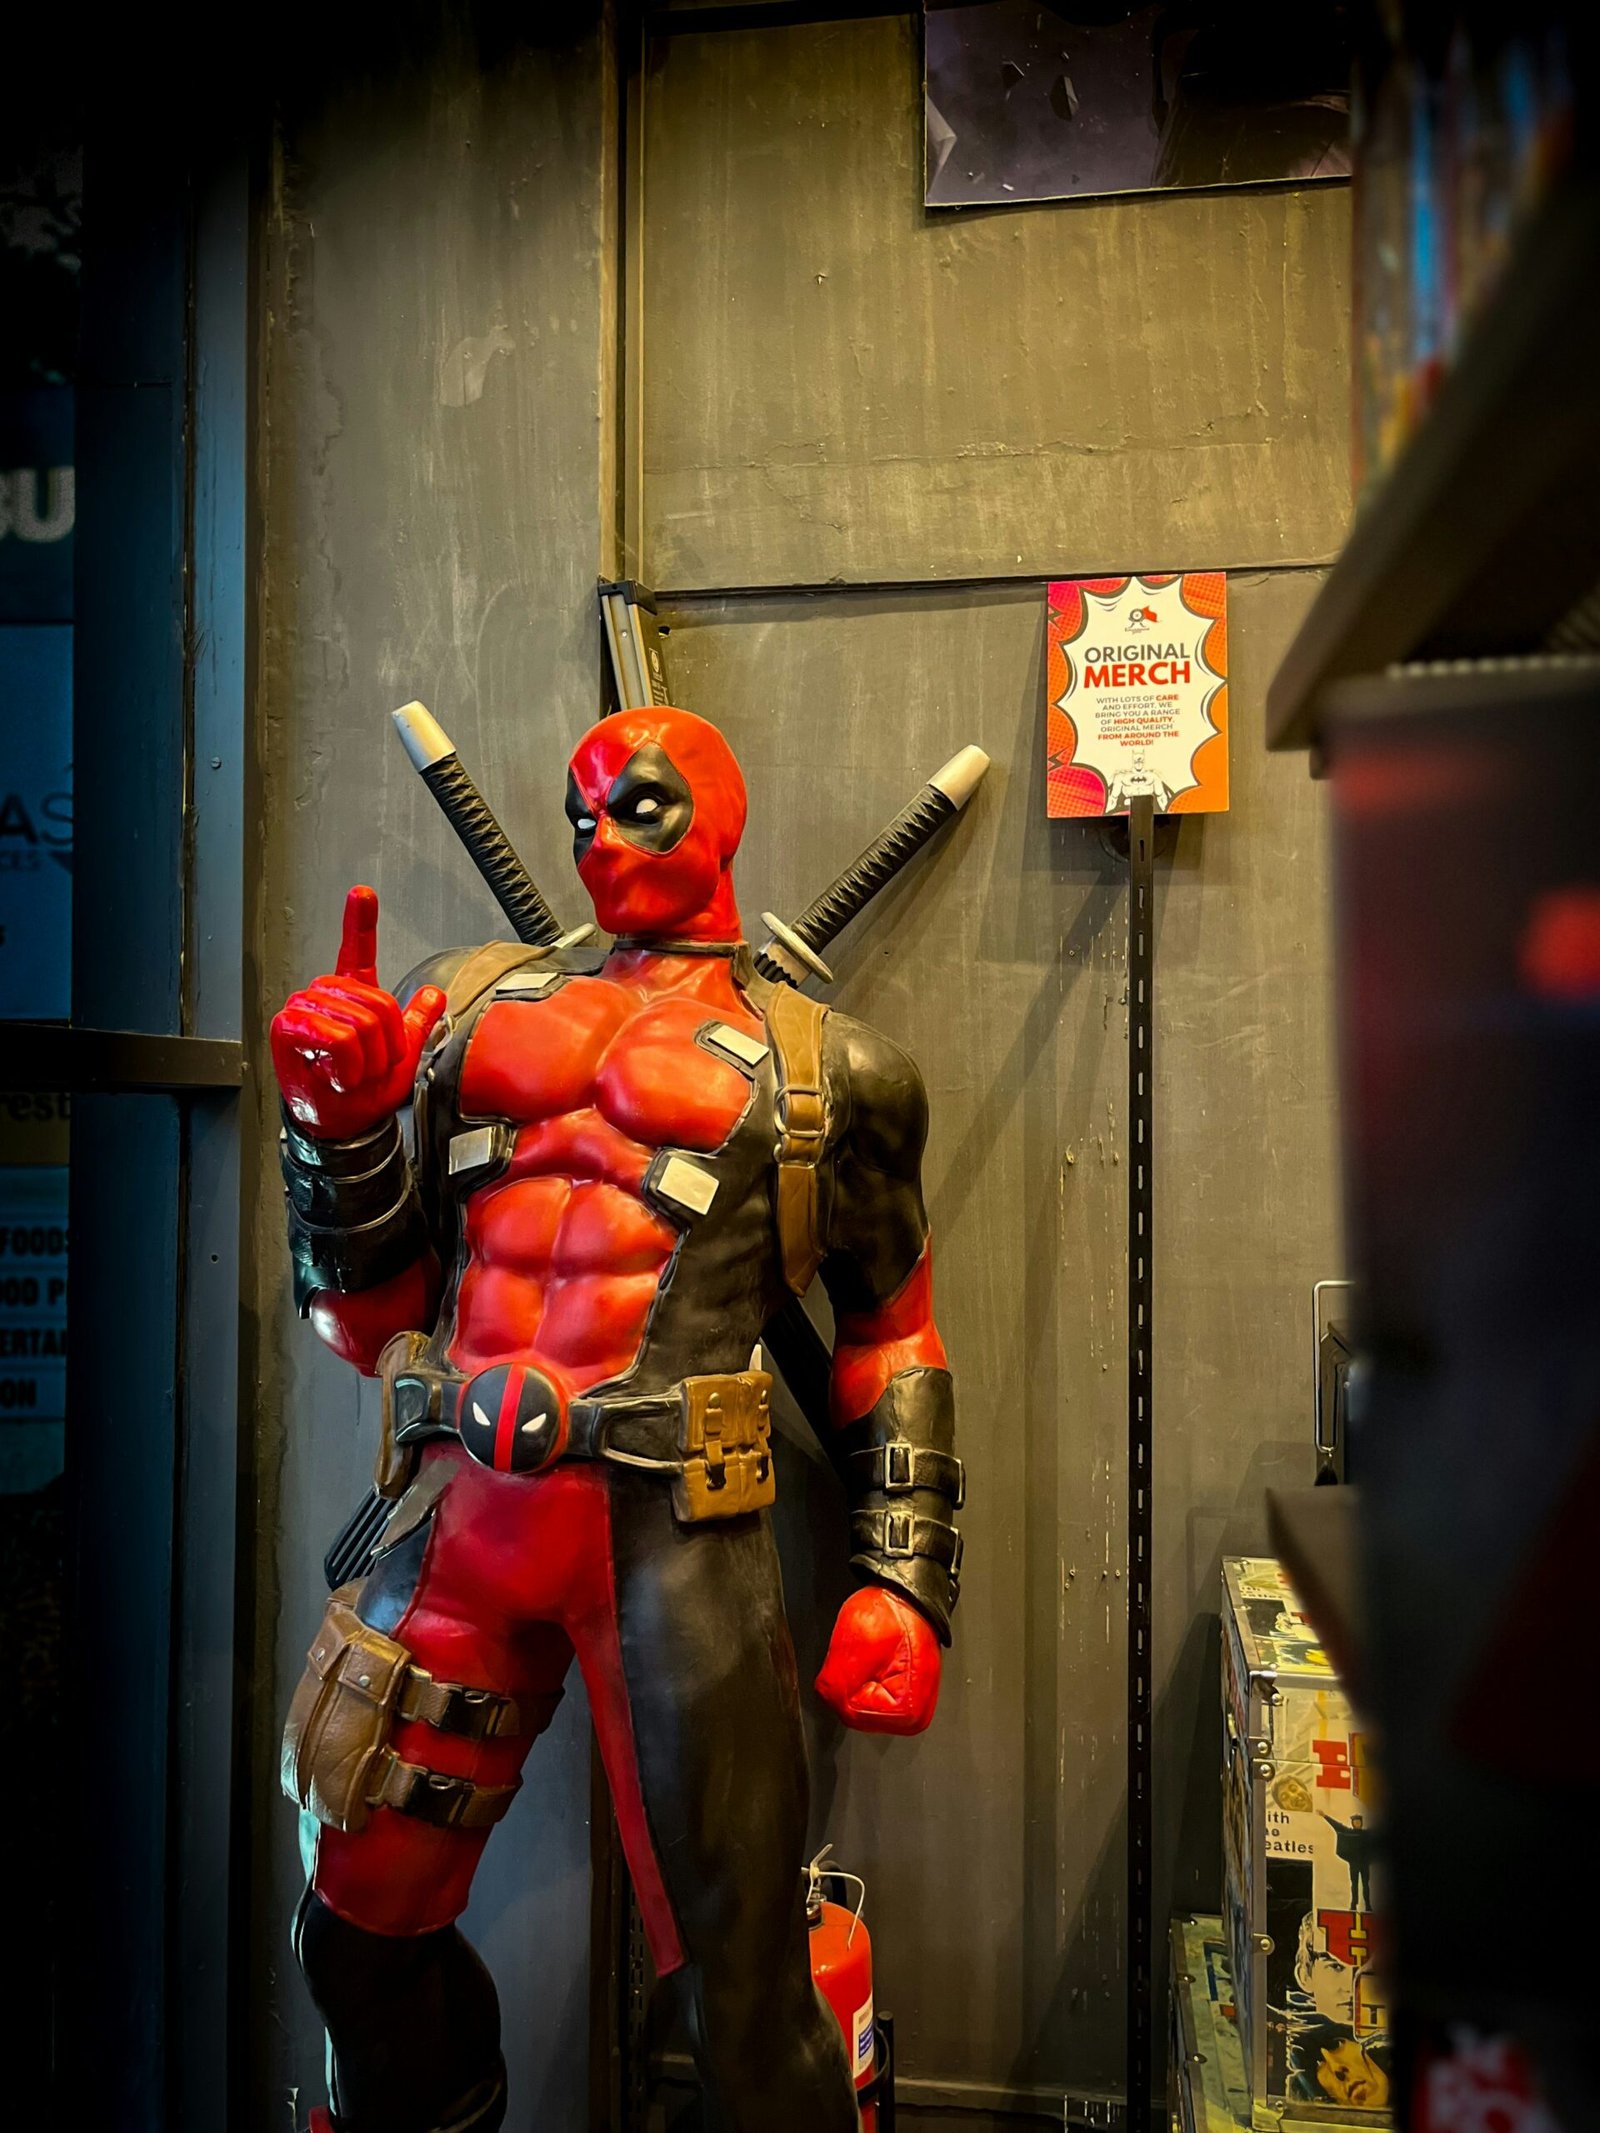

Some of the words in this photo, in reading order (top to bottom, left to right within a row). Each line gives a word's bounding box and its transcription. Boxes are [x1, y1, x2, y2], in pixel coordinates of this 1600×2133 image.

[1084, 642, 1191, 663] ORIGINAL
[1083, 661, 1191, 689] MERCH
[1120, 695, 1142, 703] LOTS
[1151, 708, 1180, 716] RANGE
[1124, 731, 1161, 739] AROUND
[1162, 730, 1180, 738] THE
